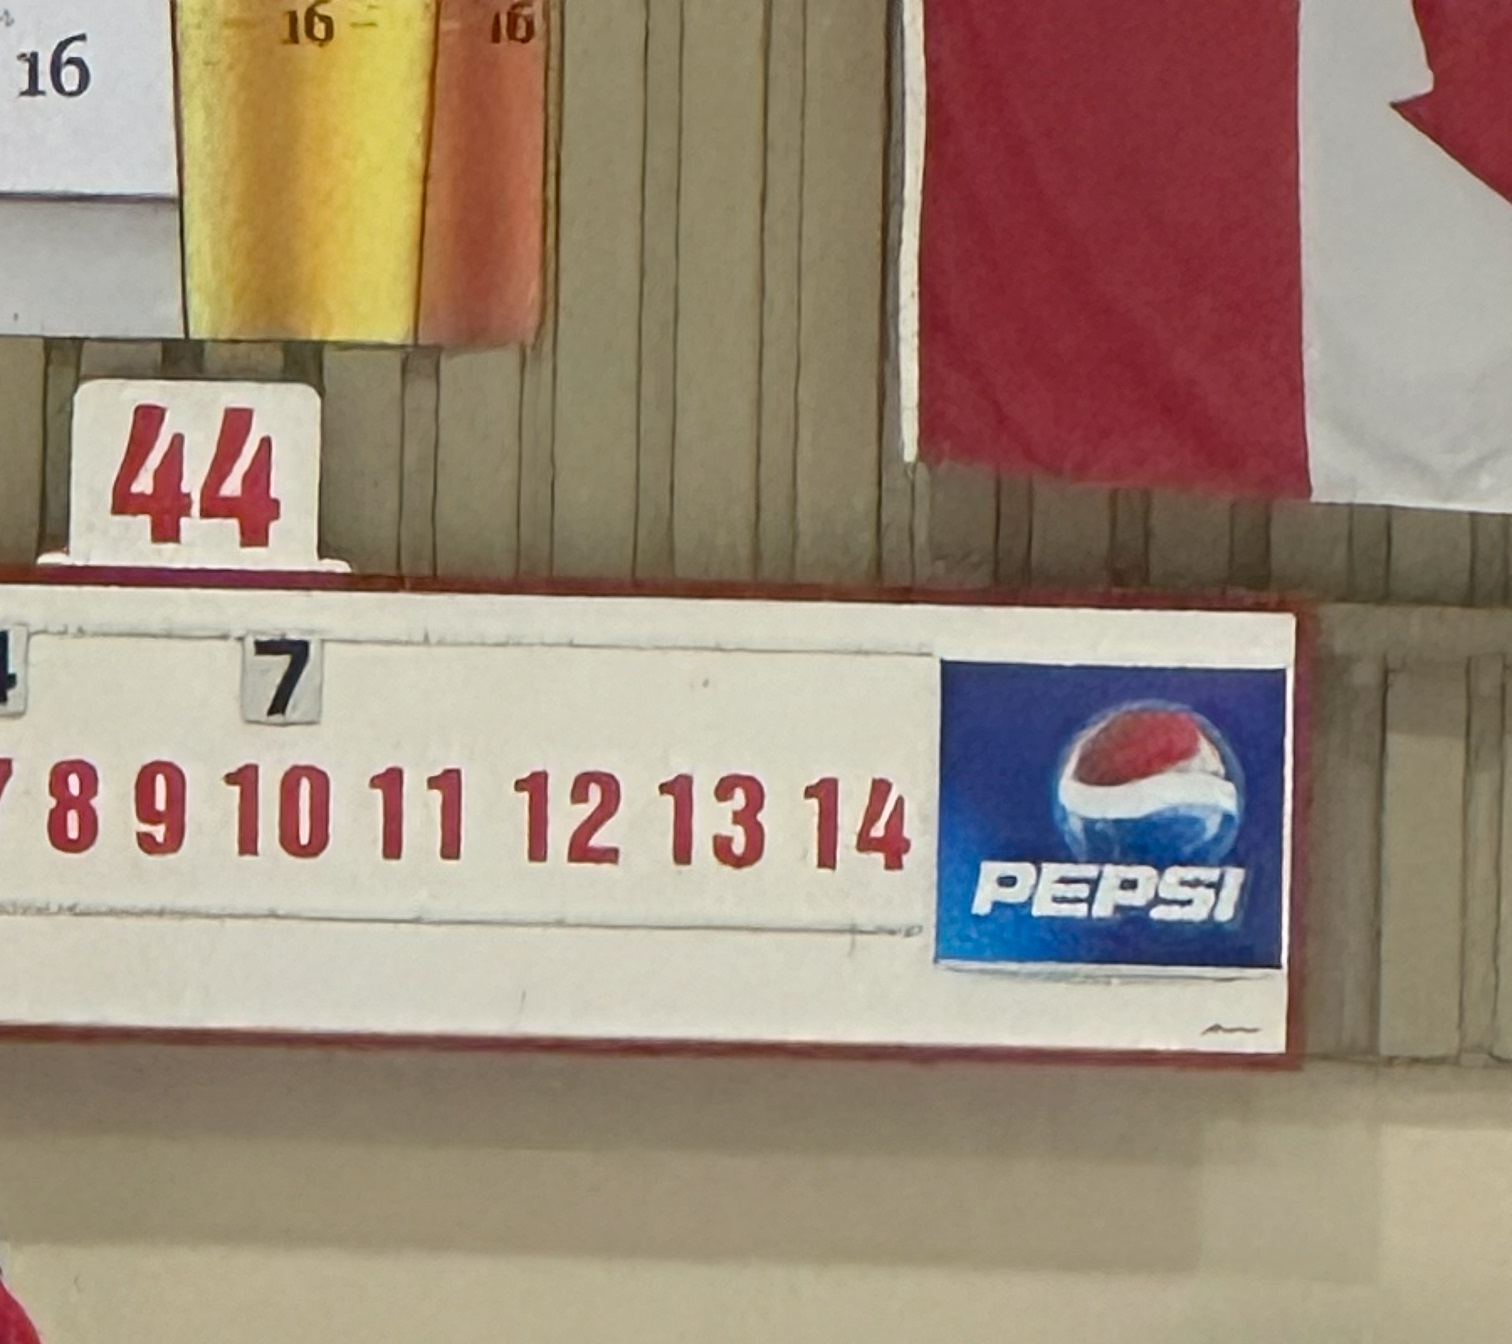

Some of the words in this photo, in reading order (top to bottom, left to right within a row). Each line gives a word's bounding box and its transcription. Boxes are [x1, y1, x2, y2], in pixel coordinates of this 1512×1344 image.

[283, 0, 334, 47] 16
[491, 1, 535, 44] 16
[16, 33, 91, 98] 16
[111, 404, 280, 548] 44
[253, 638, 310, 717] 7
[47, 759, 98, 854] 8
[134, 761, 186, 856] 9
[226, 764, 329, 858] 10
[370, 767, 461, 859] 11
[517, 771, 620, 864] 12
[660, 774, 764, 870] 13
[805, 778, 909, 870] 14
[971, 860, 1245, 923] PEPSI
